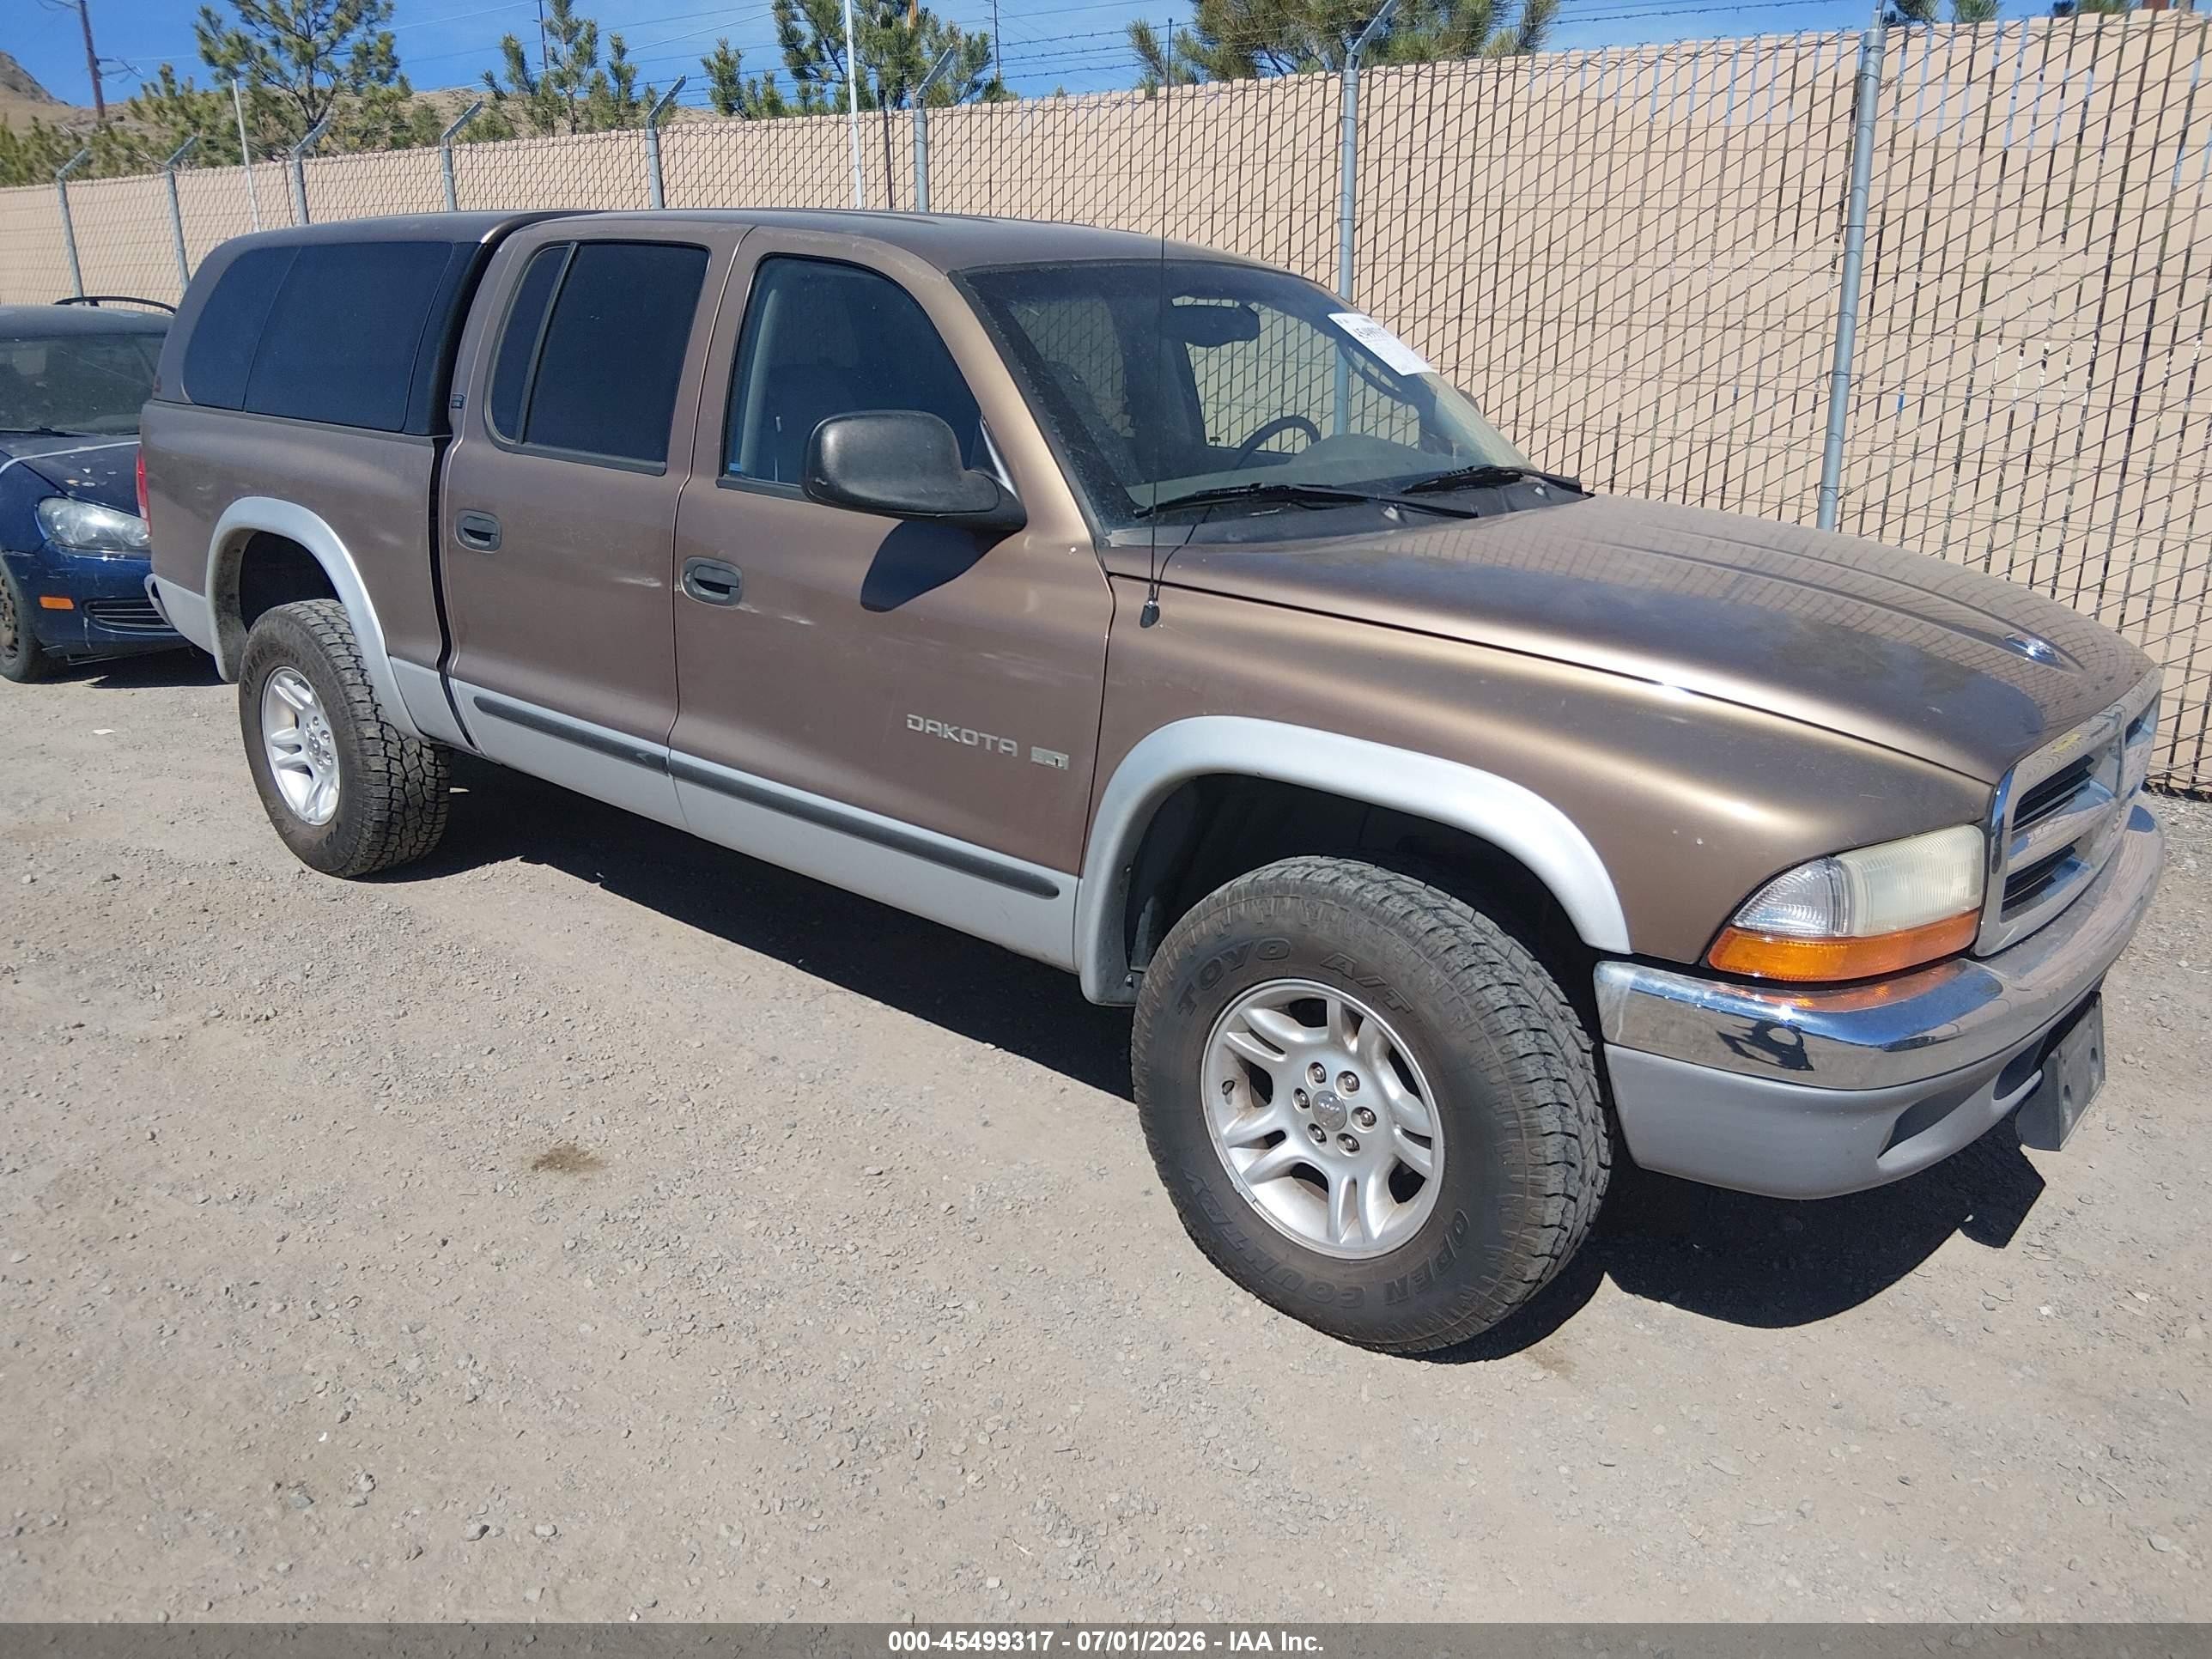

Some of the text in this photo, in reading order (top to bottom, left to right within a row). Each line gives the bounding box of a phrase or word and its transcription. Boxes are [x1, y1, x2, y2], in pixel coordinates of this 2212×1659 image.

[906, 714, 1018, 757] DAKOTA
[1177, 937, 1413, 1016] TOYO A/T
[1181, 1167, 1470, 1309] OPEN COUNTRY
